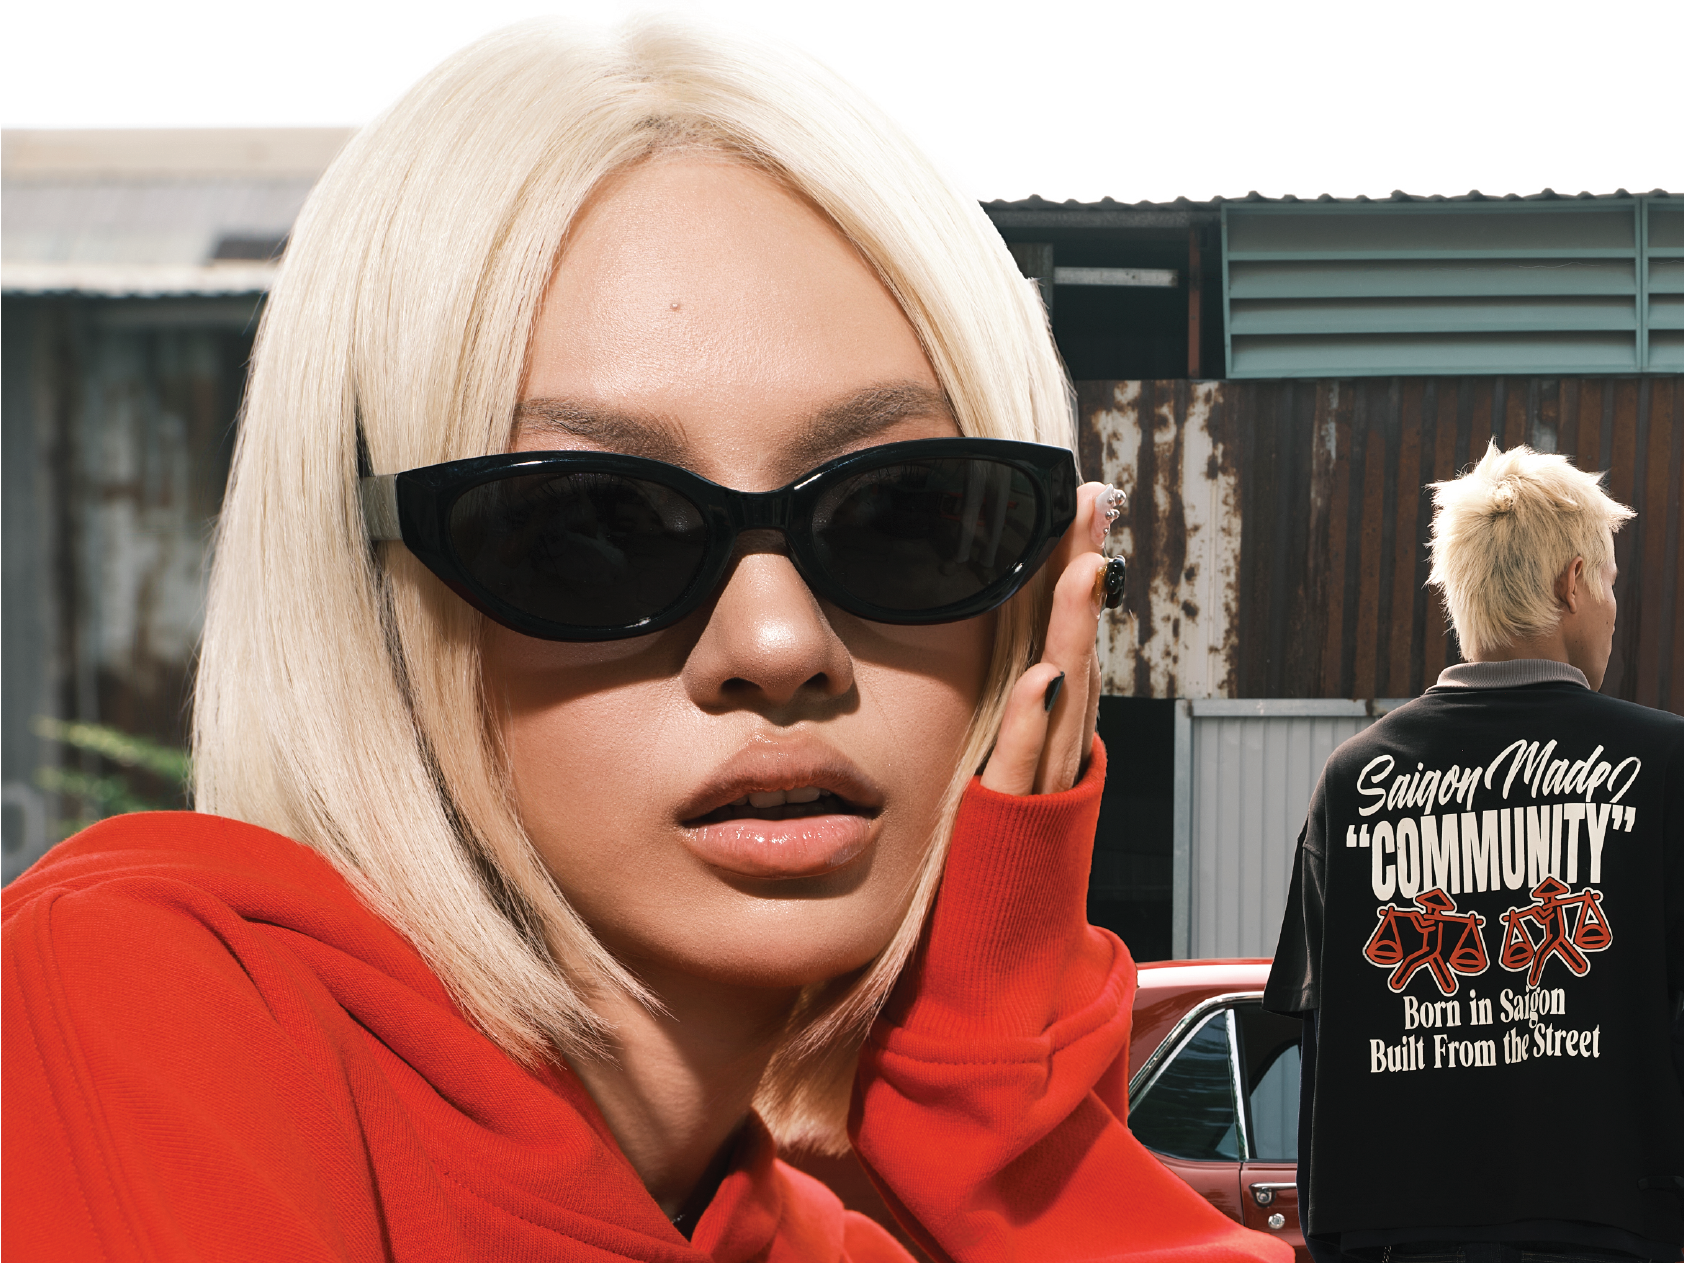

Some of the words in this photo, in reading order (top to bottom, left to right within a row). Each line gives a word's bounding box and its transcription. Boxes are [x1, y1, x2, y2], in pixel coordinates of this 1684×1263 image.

[1357, 755, 1483, 816] Saigon
[1484, 739, 1642, 804] Made
[1403, 996, 1461, 1030] Born
[1469, 988, 1494, 1026] in
[1500, 986, 1566, 1029] Saigon
[1370, 1033, 1426, 1073] Built
[1433, 1033, 1497, 1069] From
[1503, 1026, 1531, 1065] the
[1533, 1022, 1601, 1059] Street
